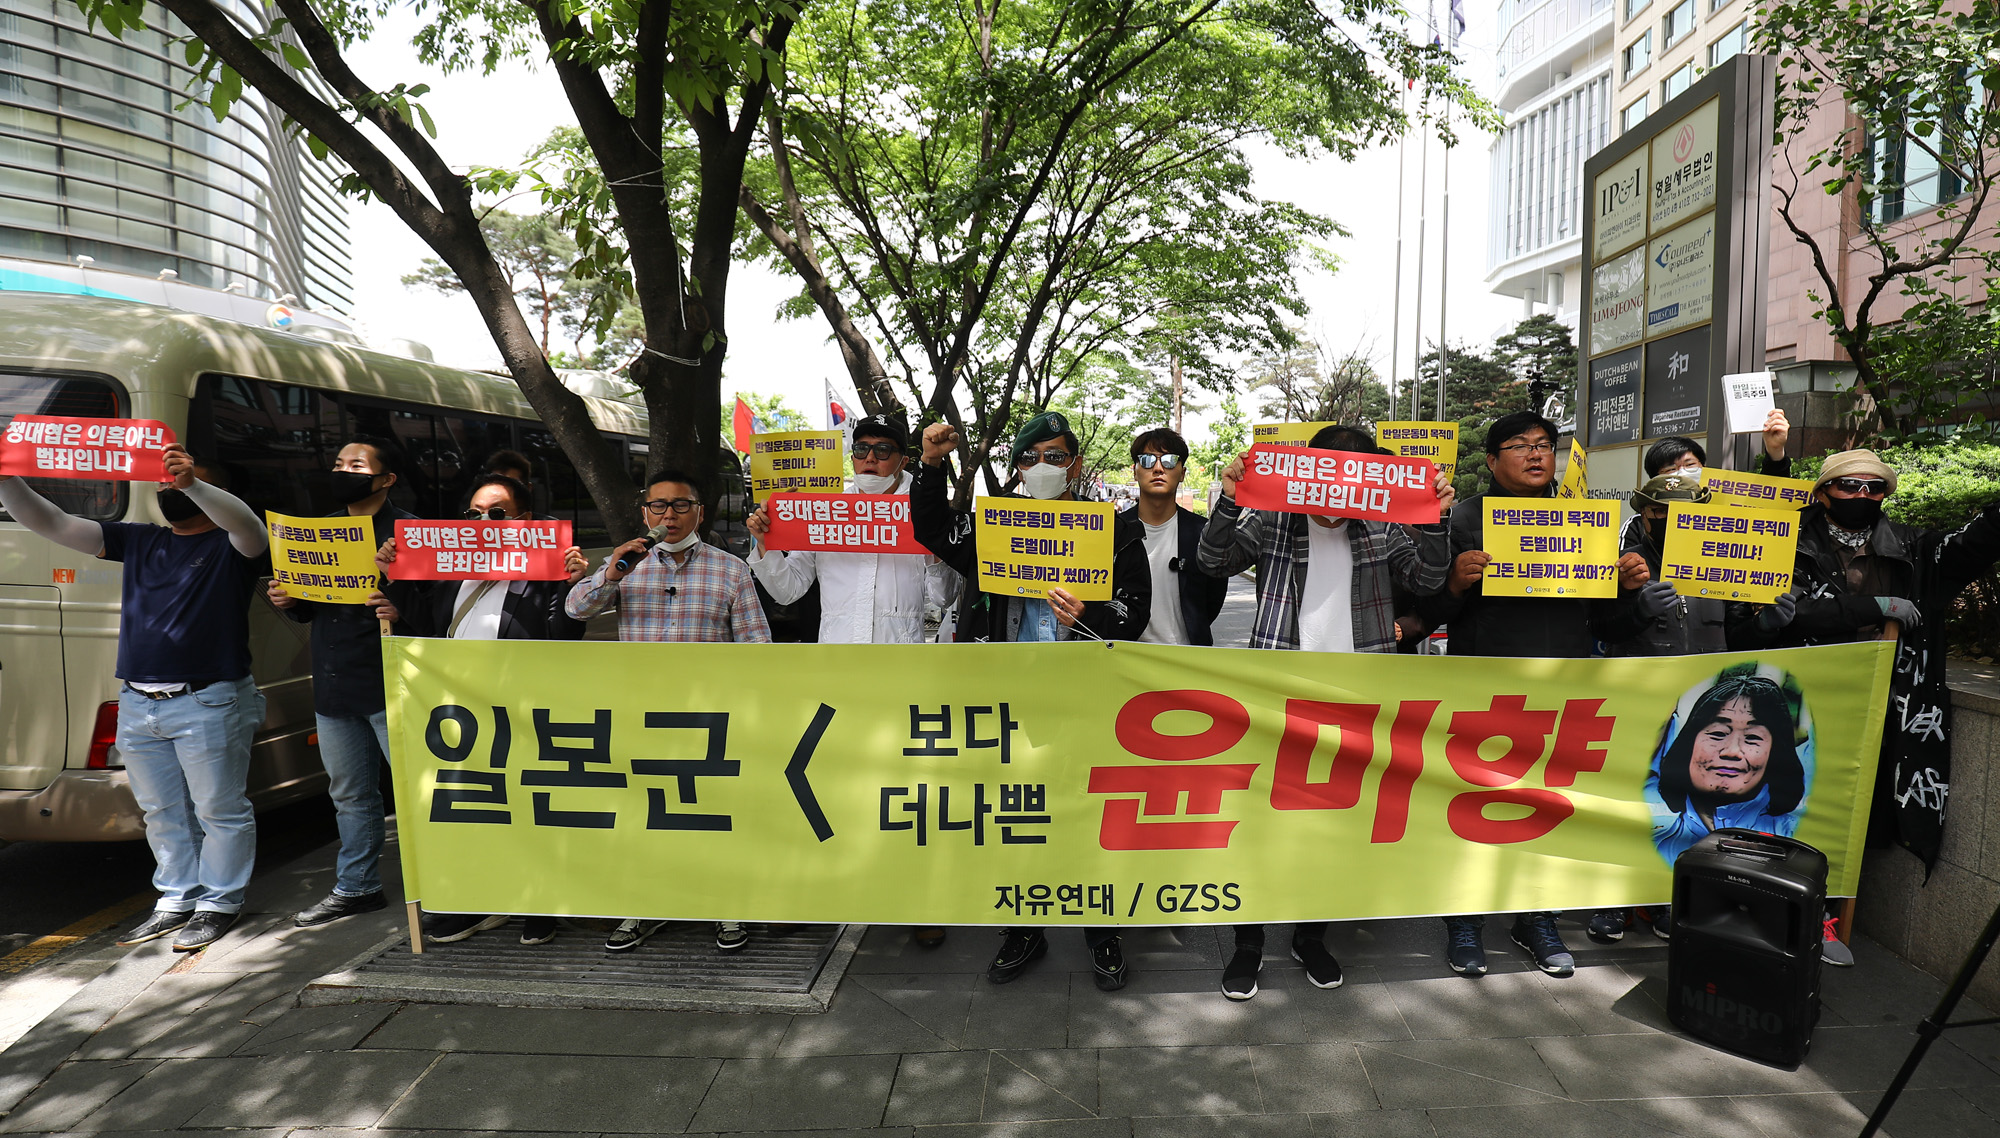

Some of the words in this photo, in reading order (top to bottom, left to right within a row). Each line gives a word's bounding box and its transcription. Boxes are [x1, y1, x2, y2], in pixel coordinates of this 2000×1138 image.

[1656, 151, 1712, 198] 영일세무법인
[1601, 167, 1641, 217] IP&I
[1682, 178, 1703, 194] Accounting
[1593, 294, 1644, 323] LIM&JEONG
[1668, 351, 1689, 380] 和
[1604, 374, 1627, 388] COFFEE
[1594, 392, 1635, 416] 커피전문점
[1674, 408, 1698, 419] Restaurant
[1597, 412, 1630, 433] 더치앤빈
[1689, 419, 1699, 431] 2F
[6, 421, 83, 446] 정대협은
[86, 425, 164, 450] 의혹아닌
[1383, 428, 1428, 439] 반일운동의
[1431, 429, 1454, 440] 목적이
[1631, 428, 1640, 440] 1F
[755, 439, 802, 454] 반일운동의
[804, 438, 836, 451] 목적이
[1400, 445, 1439, 456] 돈벌이냐!
[36, 447, 134, 473] 범죄입니다
[772, 457, 816, 471] 돈벌이냐!
[1254, 451, 1337, 482] 정대협은
[1343, 459, 1427, 490] 의혹아닌
[1434, 463, 1454, 473] 어??
[754, 479, 771, 491] 그돈
[771, 477, 807, 490] 늬들끼리
[808, 476, 841, 488] 썼어??
[1594, 488, 1636, 500] ShinYoun
[1708, 478, 1777, 500] 반일운동의
[1286, 480, 1391, 514] 범죄입니다
[775, 500, 849, 522] 정대협은
[854, 501, 911, 523] 의혹아
[984, 508, 1055, 529] 반일운동의
[1059, 513, 1104, 531] 목적이
[1492, 509, 1563, 527] 반일운동의
[1567, 511, 1610, 528] 목적이
[270, 522, 317, 543] 반일운동의
[319, 527, 364, 543] 목적이
[808, 524, 899, 546] 범죄입니다
[1677, 513, 1749, 534] 반일운동의
[1752, 519, 1790, 537] 목적이
[403, 527, 478, 549] 정대협은
[482, 527, 557, 549] 의혹아닌
[1010, 537, 1075, 557] 돈벌이냐!
[1520, 536, 1582, 553] 돈벌이냐!
[287, 549, 340, 566] 돈벌이냐!
[1702, 540, 1763, 561] 돈벌이냐!
[436, 551, 529, 573] 범죄입니다
[982, 561, 1006, 578] 그돈
[1009, 564, 1060, 583] 늬들끼리
[1063, 568, 1109, 584] 썼어??
[1488, 562, 1514, 578] 그돈
[1518, 563, 1569, 579] 늬들끼리
[1572, 564, 1615, 580] 썼어??
[53, 568, 76, 584] NEW
[291, 571, 333, 588] 늬들끼리
[334, 575, 376, 588] 썼어??
[1665, 563, 1693, 579] 그돈
[1696, 567, 1747, 584] 늬들끼리
[1750, 570, 1789, 588] 썼어??
[902, 703, 1019, 764] 보다
[425, 703, 741, 832] 일본군
[1086, 688, 1617, 851] 윤미향
[880, 783, 1052, 847] 더나쁜
[993, 882, 1115, 917] 자유연대
[1155, 883, 1242, 913] GZSS
